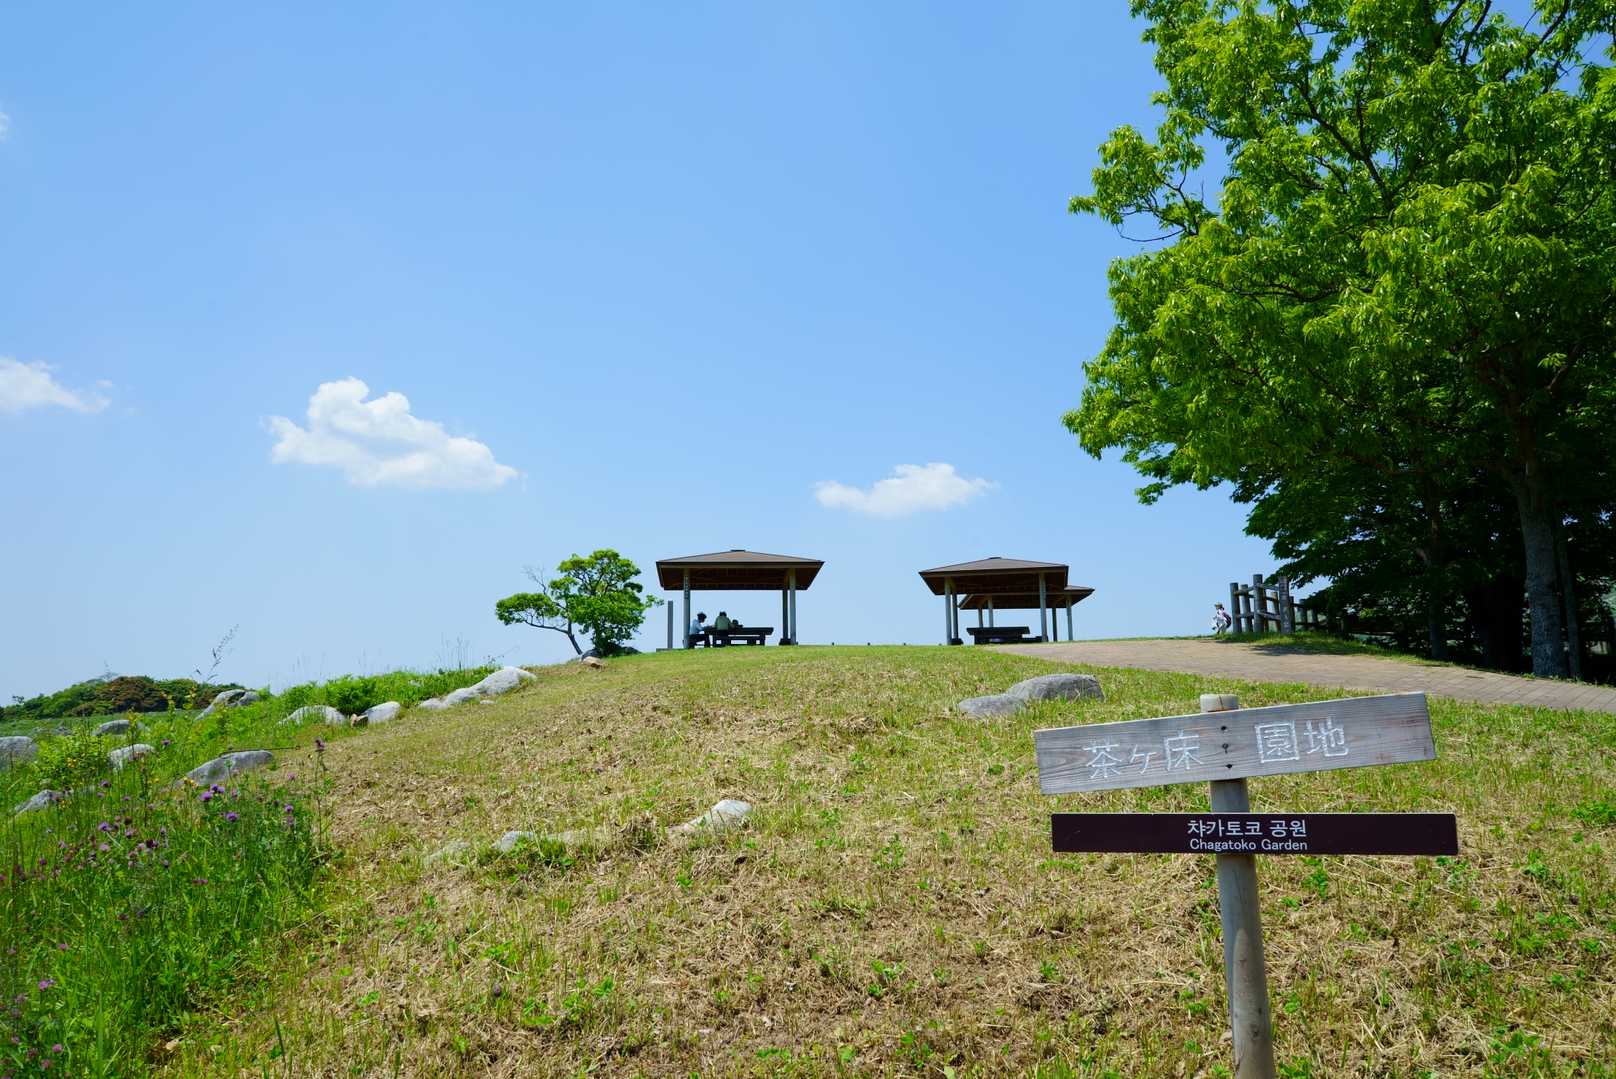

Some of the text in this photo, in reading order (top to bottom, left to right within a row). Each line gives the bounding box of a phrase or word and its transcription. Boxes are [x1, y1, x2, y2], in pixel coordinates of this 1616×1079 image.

[1255, 716, 1349, 763] 園地
[1187, 819, 1307, 837] 챠가토코 공원
[1189, 838, 1308, 852] Chagatoko Garden
